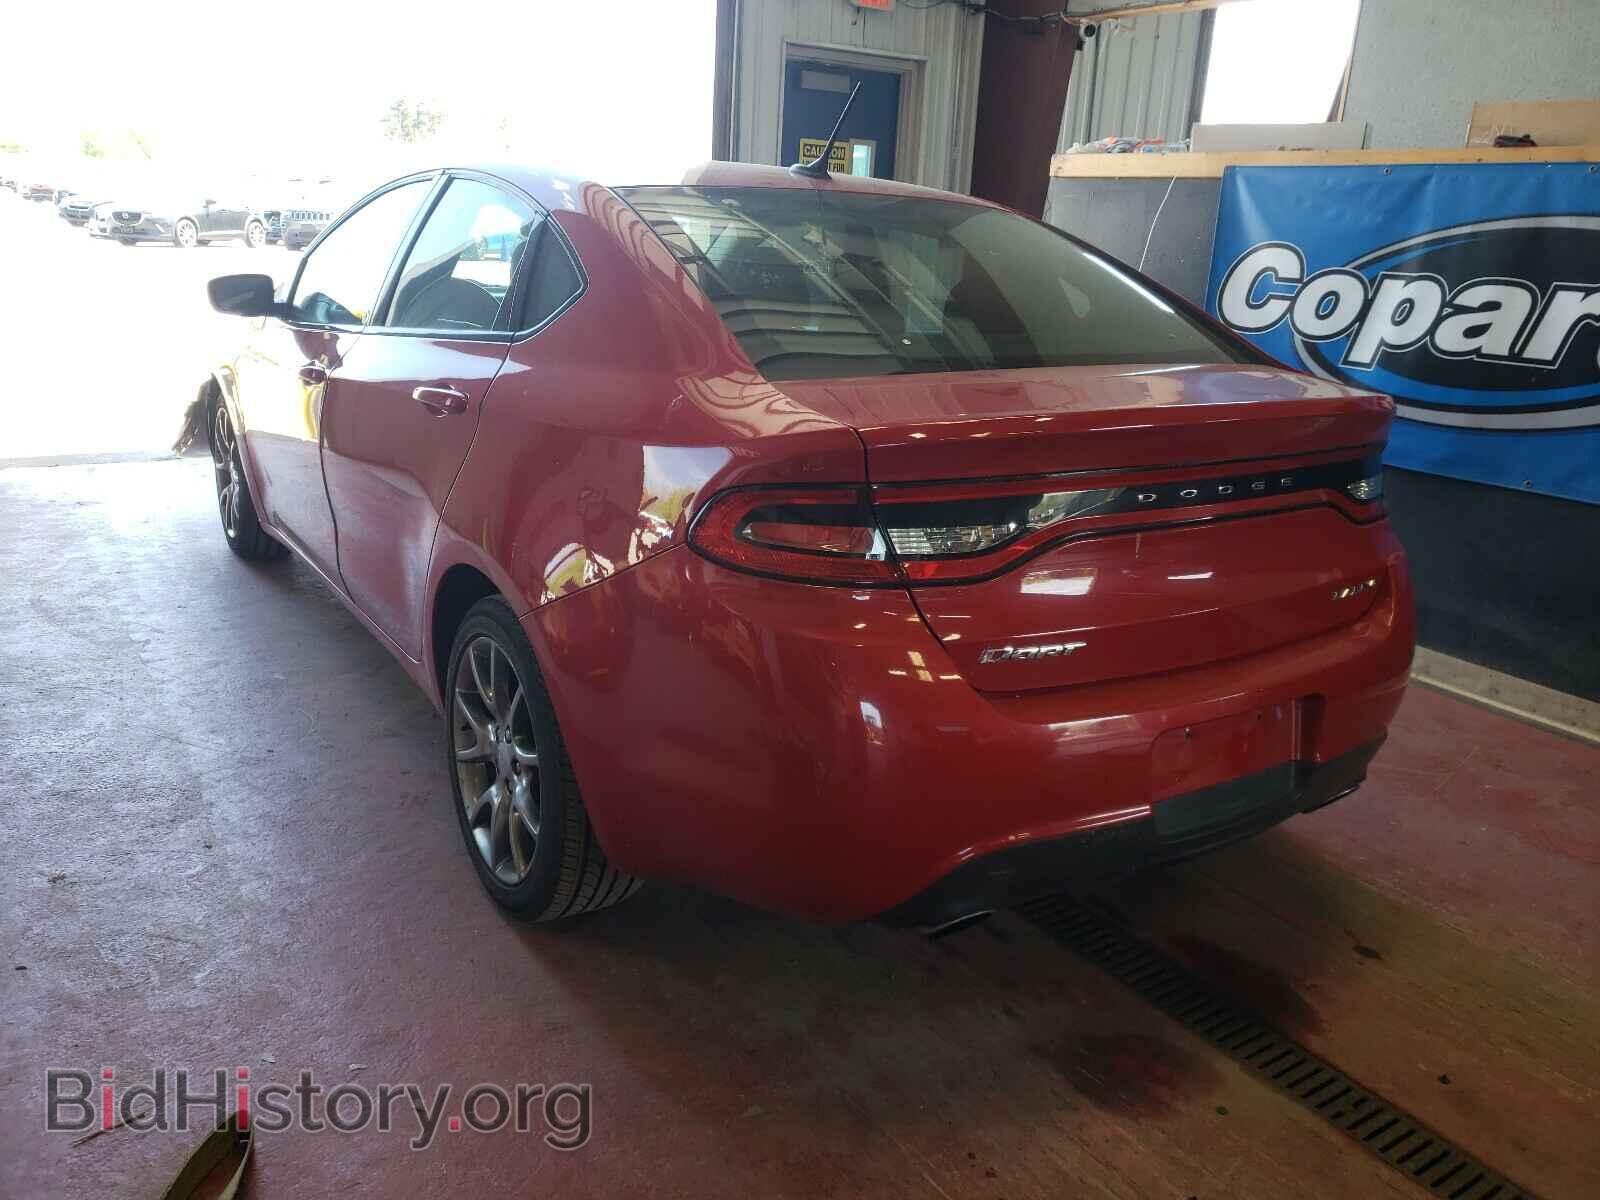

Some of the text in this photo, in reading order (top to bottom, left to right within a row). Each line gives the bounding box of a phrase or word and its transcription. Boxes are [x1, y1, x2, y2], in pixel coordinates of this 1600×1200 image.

[803, 144, 845, 160] CAUON
[1218, 241, 1600, 371] Copar
[1137, 477, 1294, 502] DODGE
